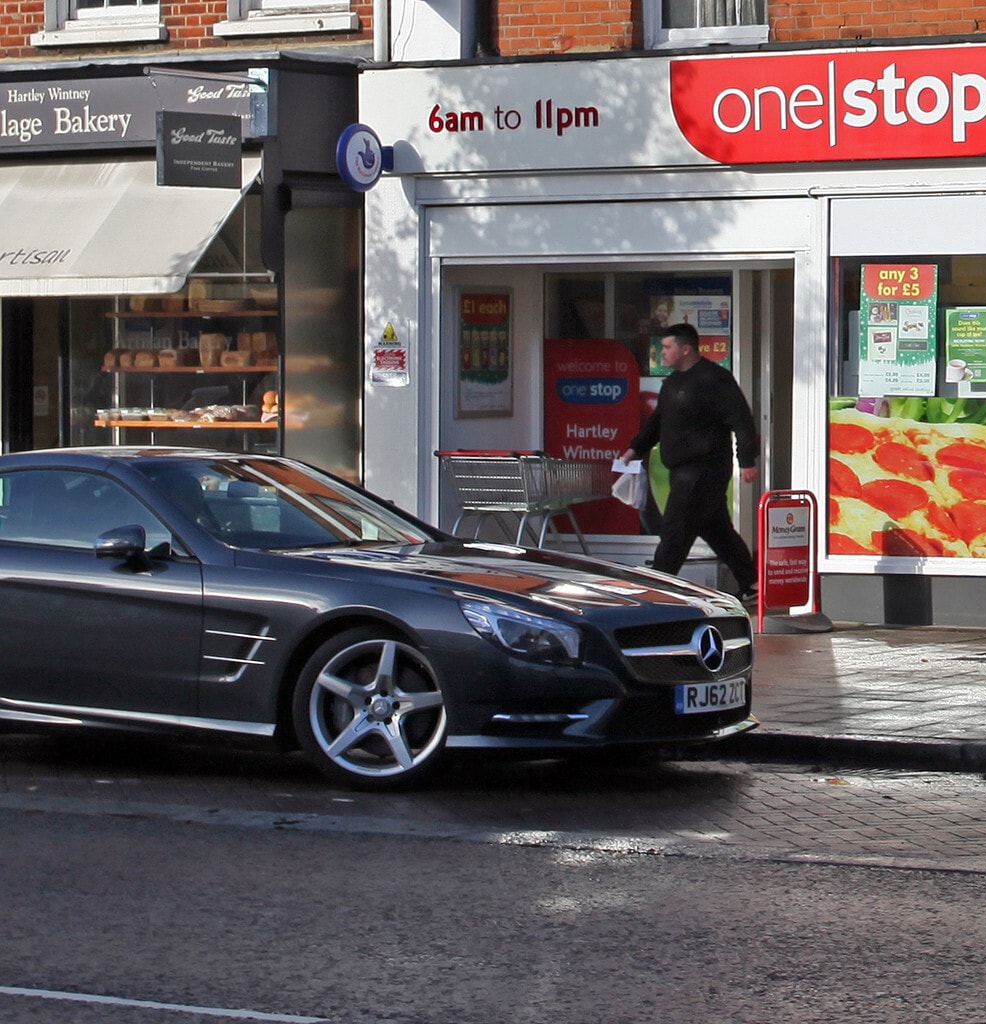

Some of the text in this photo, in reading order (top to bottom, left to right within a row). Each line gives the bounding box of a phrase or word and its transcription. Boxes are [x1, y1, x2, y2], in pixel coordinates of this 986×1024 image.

[8, 87, 91, 104] Hartley Wintney
[187, 85, 224, 103] Good
[428, 98, 600, 136] 6am to 11pm
[712, 83, 824, 134] one
[0, 105, 132, 142] lage Bakery
[170, 127, 237, 145] Good Taste
[879, 267, 919, 283] any 3
[877, 282, 920, 296] for £5
[713, 342, 727, 352] £2
[558, 361, 628, 372] welcome to
[562, 382, 621, 400] one stop
[566, 424, 618, 441] Hartley
[563, 445, 620, 459] Wintney
[687, 684, 726, 708] RJ62
